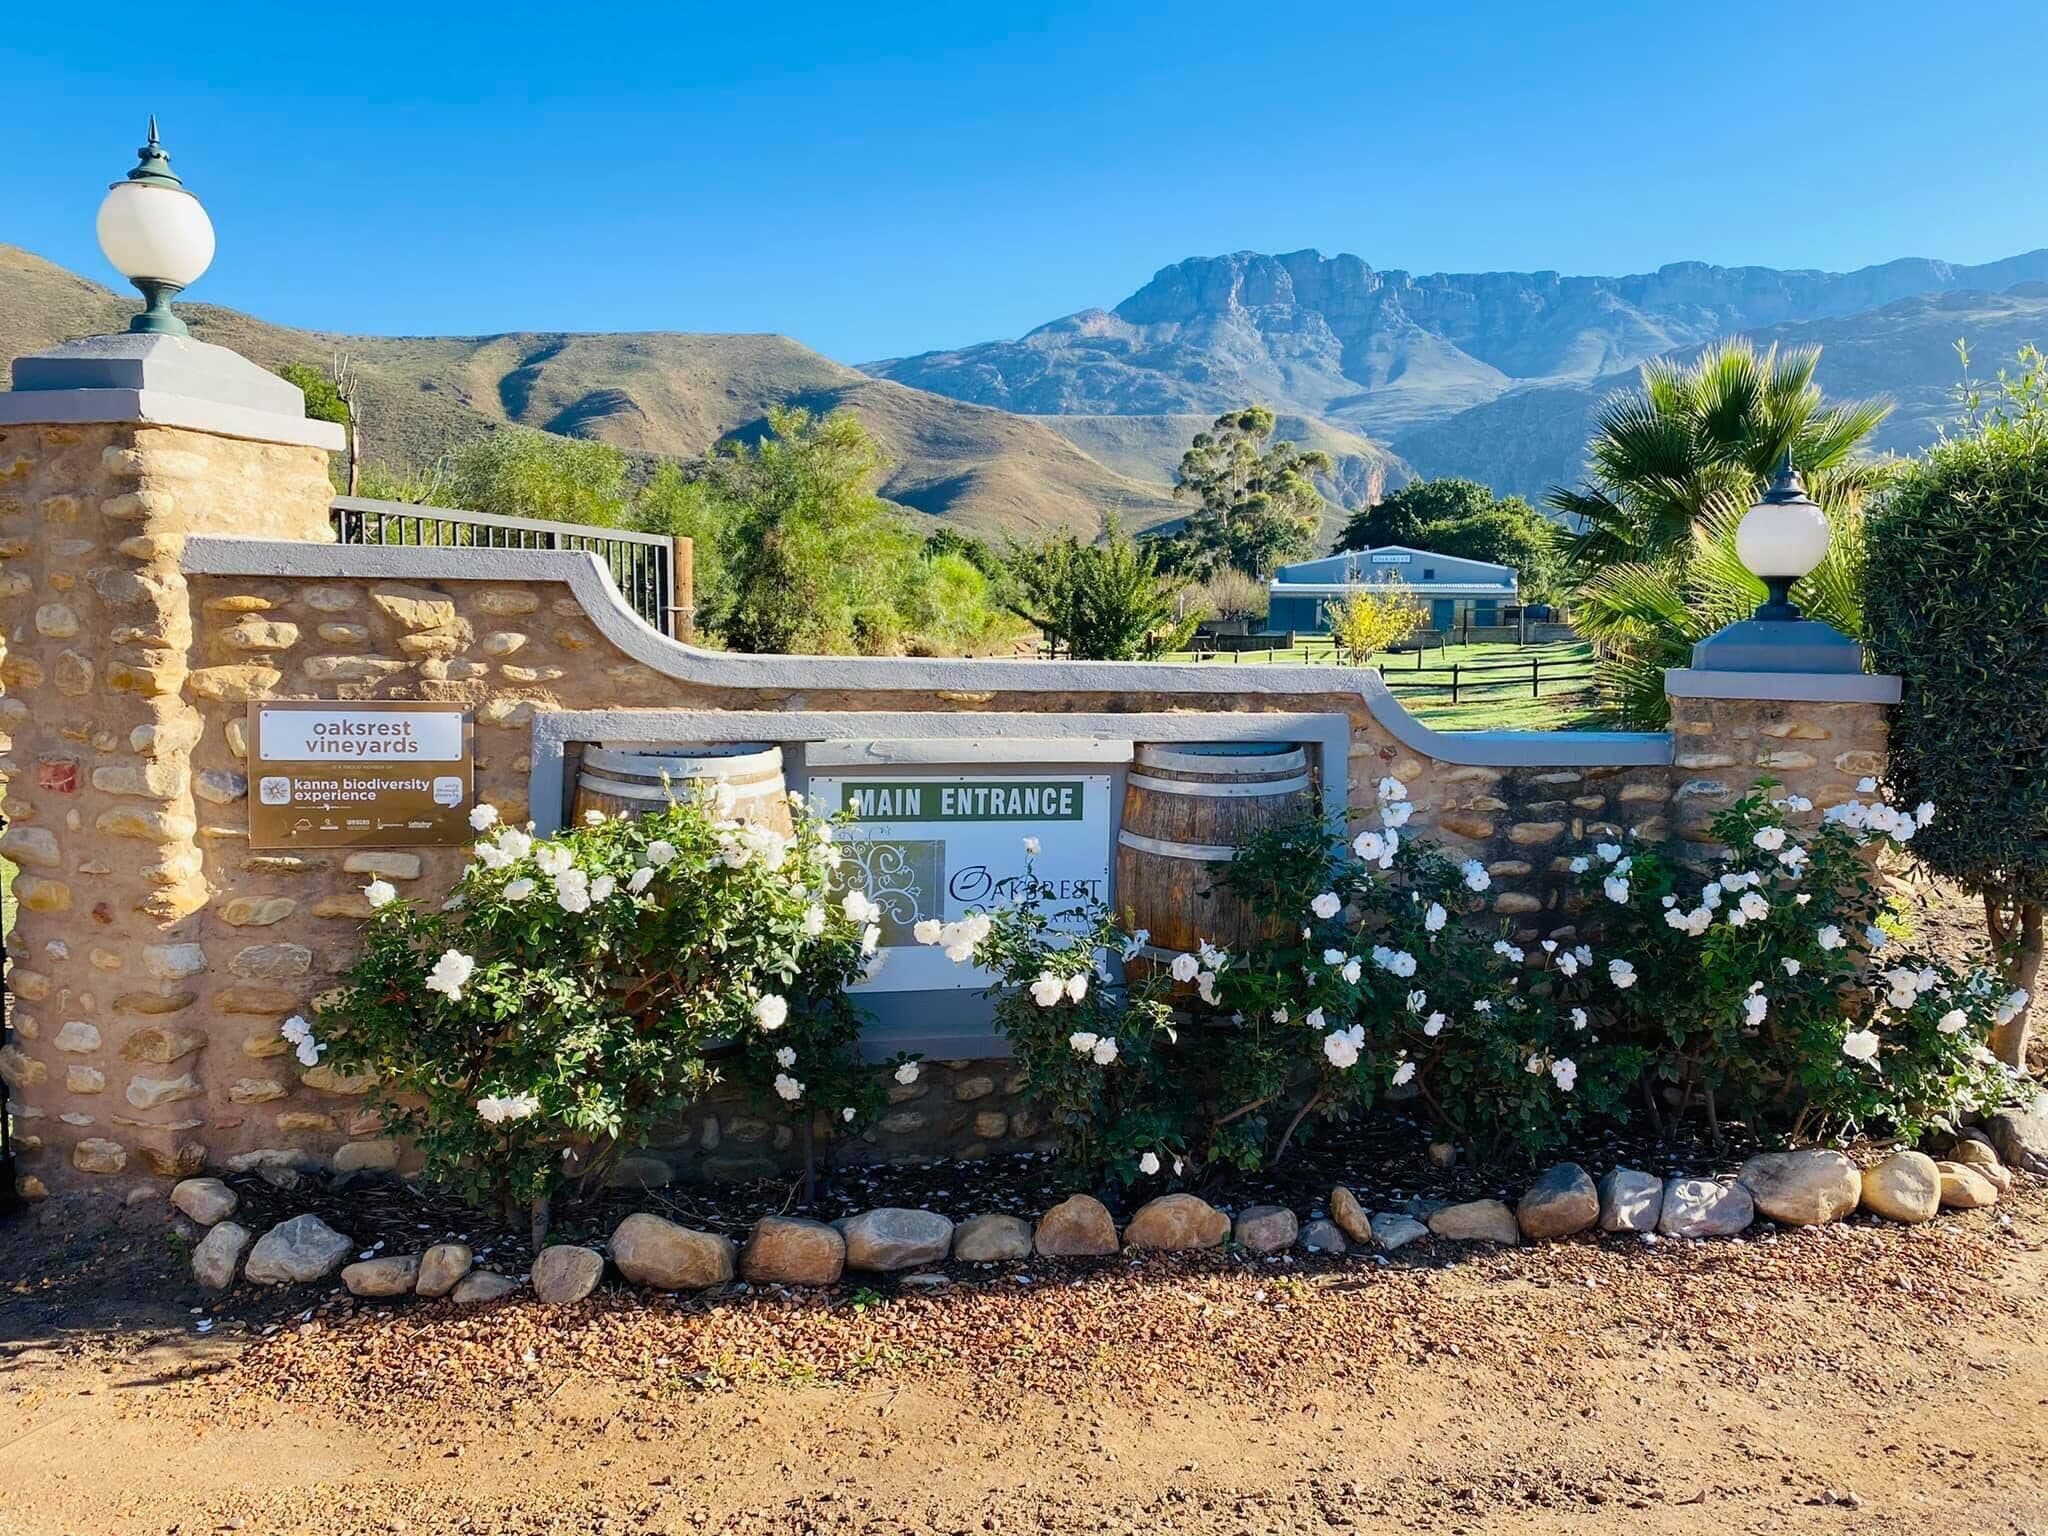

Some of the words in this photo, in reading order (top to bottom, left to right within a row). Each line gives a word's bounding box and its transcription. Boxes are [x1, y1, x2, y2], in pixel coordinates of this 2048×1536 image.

[313, 719, 411, 736] oaksrest
[305, 737, 418, 756] vineyards
[294, 779, 338, 790] kanna
[343, 779, 430, 792] biodiversity
[294, 790, 376, 802] experience
[853, 788, 921, 815] MAIN
[941, 788, 1073, 815] ENTRANCE
